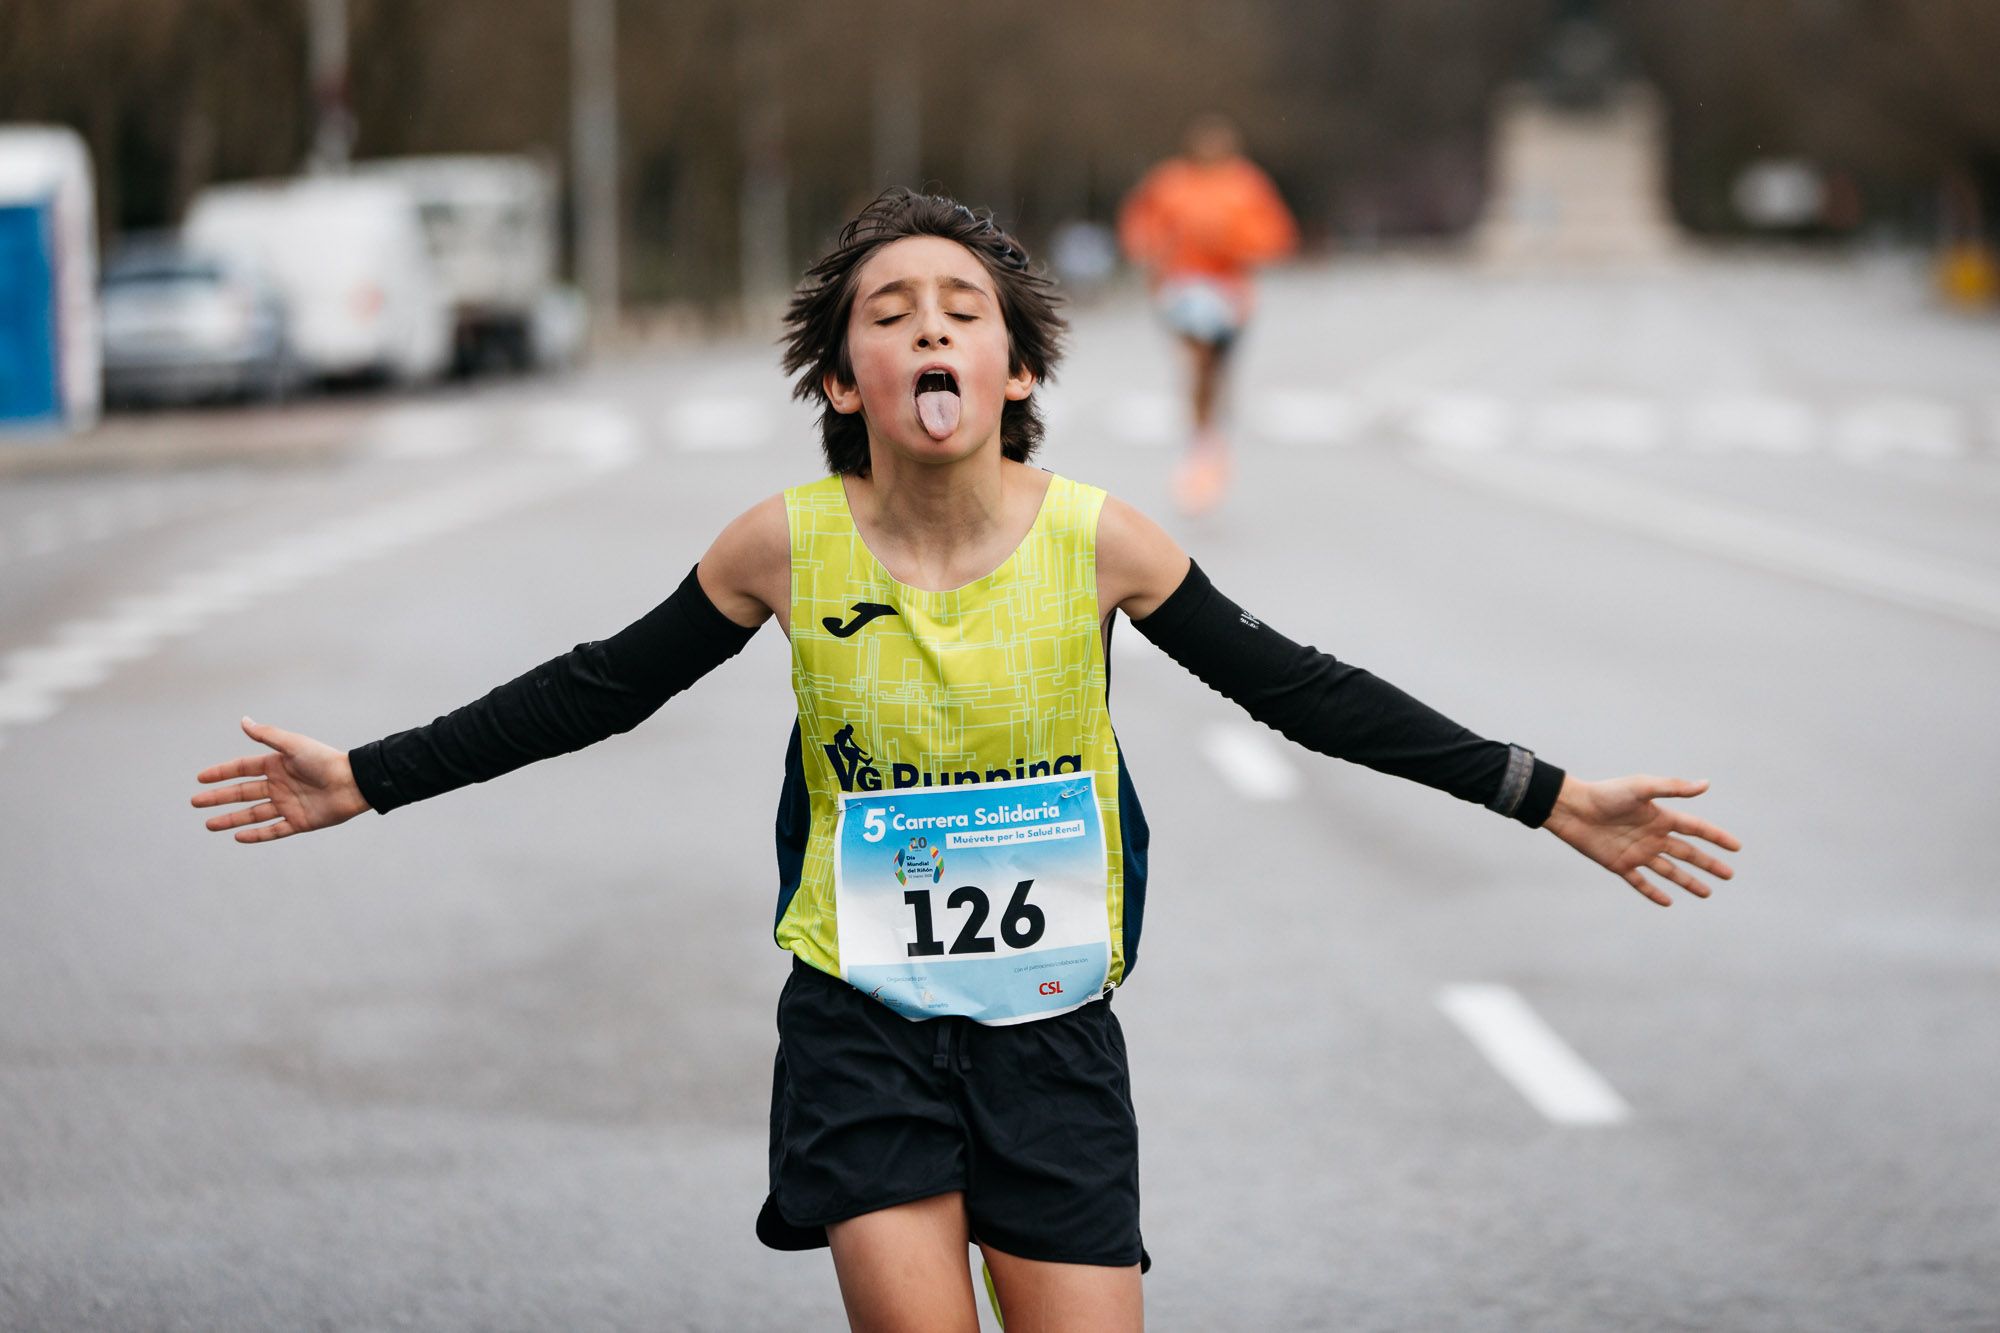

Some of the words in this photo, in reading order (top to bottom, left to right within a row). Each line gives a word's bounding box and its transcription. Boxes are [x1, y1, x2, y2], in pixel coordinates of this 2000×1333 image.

[892, 813, 969, 831] Carrera
[974, 801, 1061, 826] Solidaria
[953, 834, 995, 844] Muévete
[997, 834, 1012, 843] por
[1016, 831, 1025, 839] la
[1028, 827, 1053, 838] Salud
[1055, 824, 1081, 835] Renal
[904, 879, 1046, 957] 126
[1039, 981, 1063, 995] CSL
